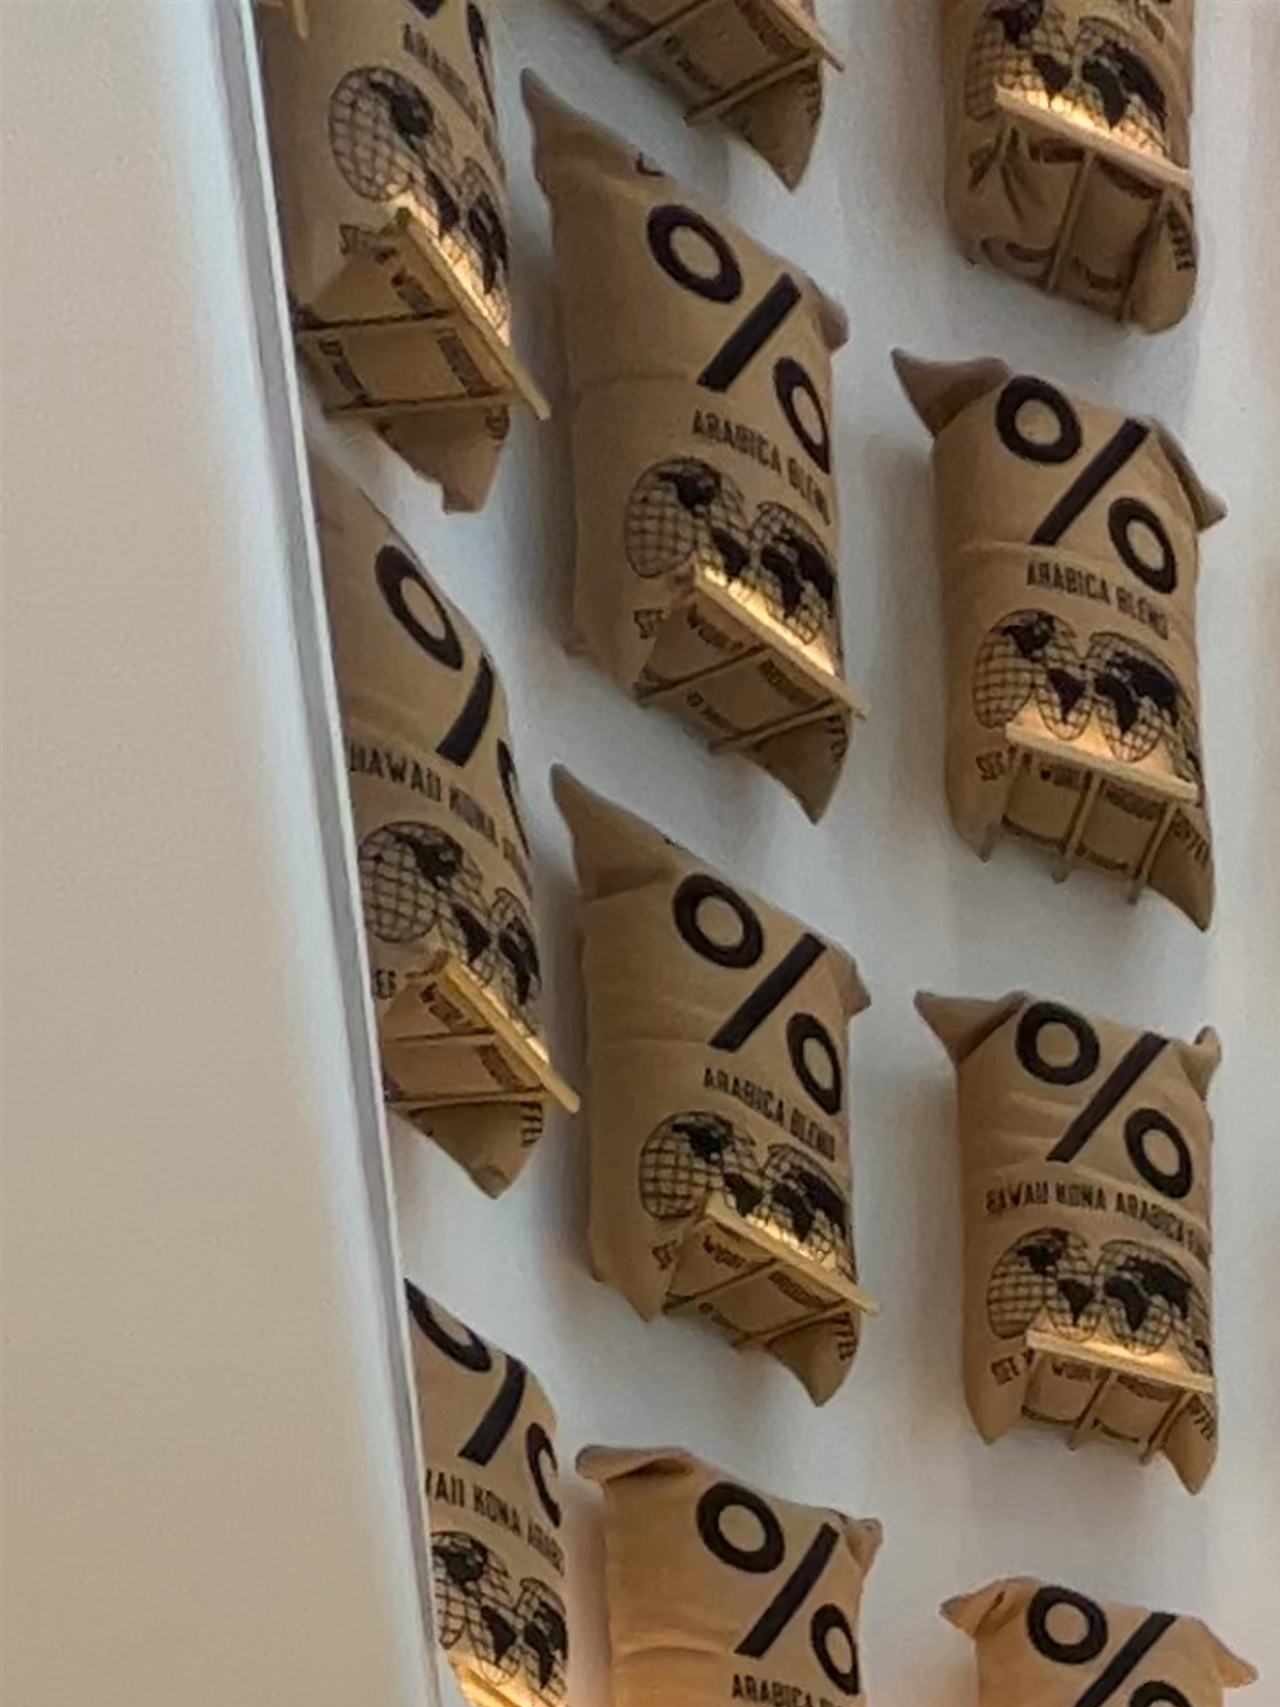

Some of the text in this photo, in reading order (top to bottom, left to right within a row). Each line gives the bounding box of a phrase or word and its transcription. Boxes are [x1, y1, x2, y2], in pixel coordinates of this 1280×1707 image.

[692, 409, 781, 475] ARABICA
[1025, 562, 1111, 605] ARABICA
[704, 1067, 784, 1127] ARABICA
